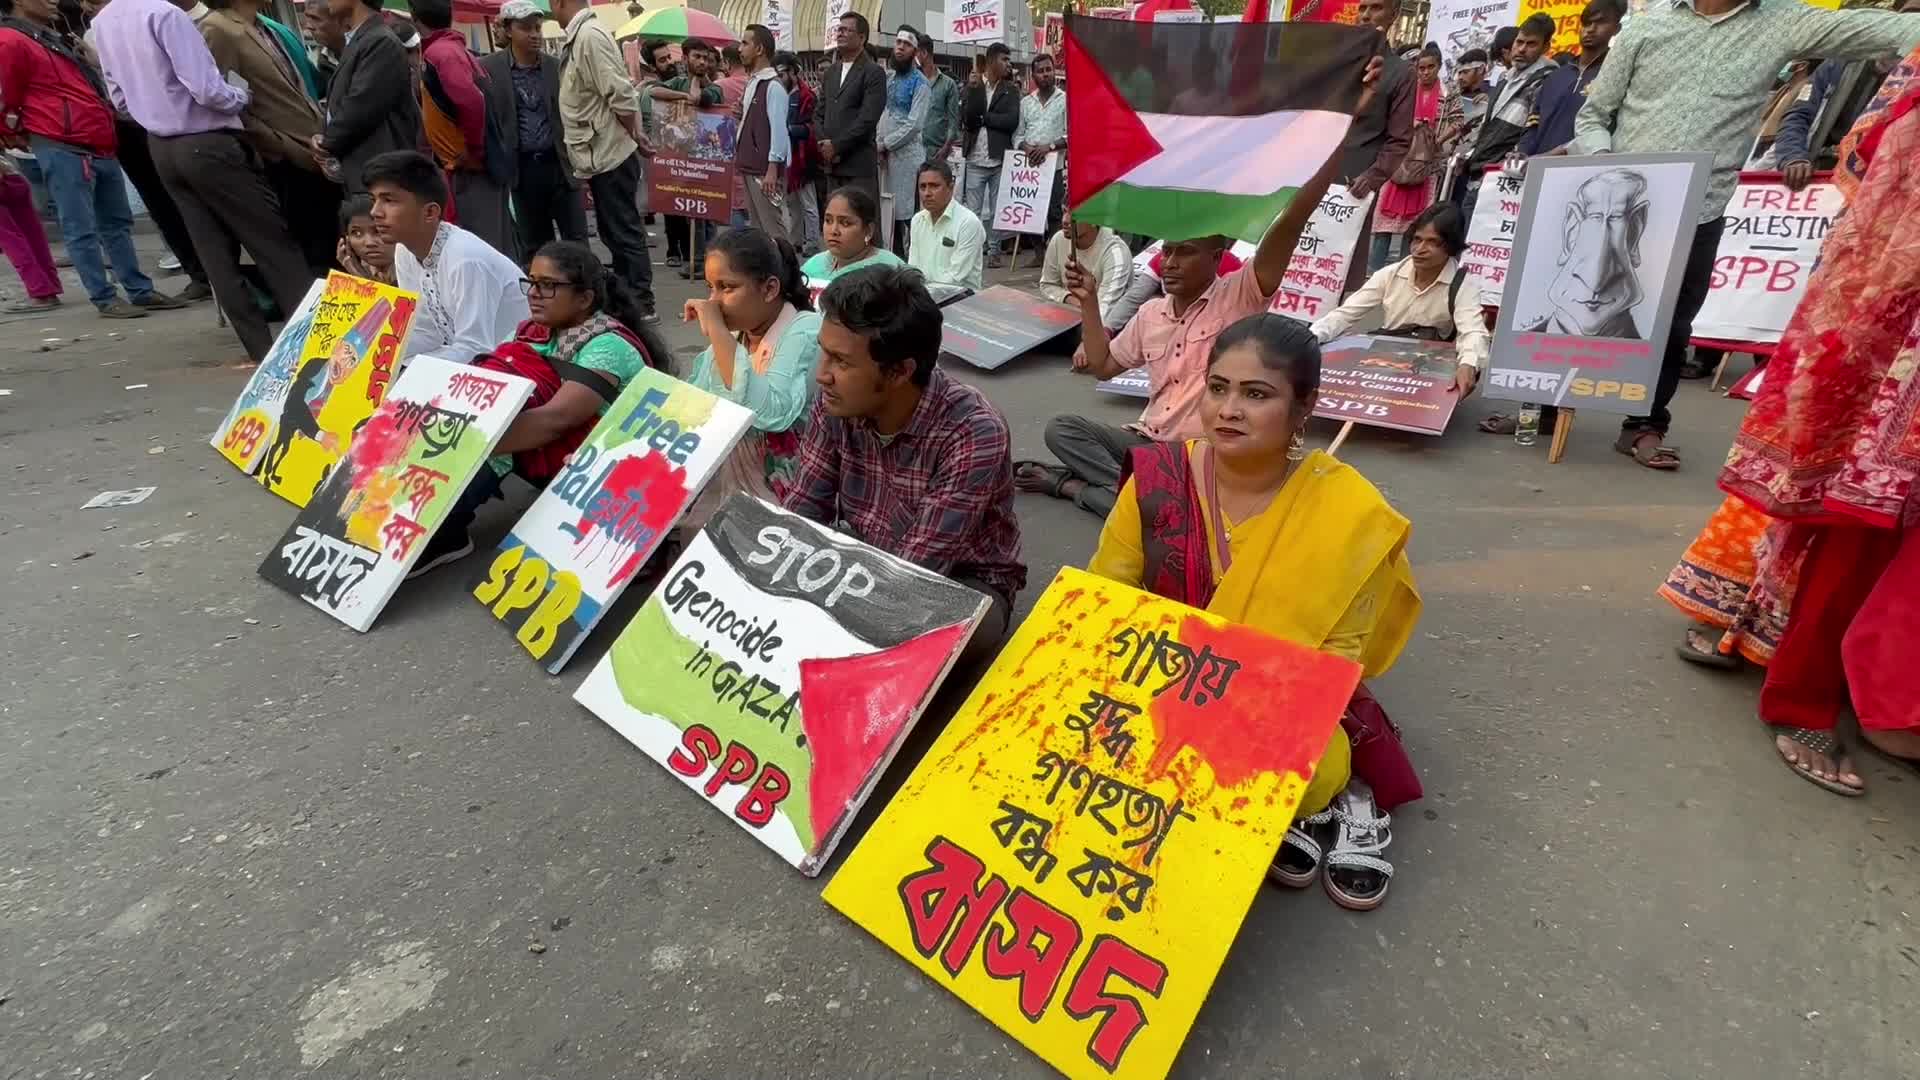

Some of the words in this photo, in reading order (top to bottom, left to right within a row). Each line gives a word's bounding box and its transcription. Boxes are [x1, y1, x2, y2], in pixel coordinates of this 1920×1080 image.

[952, 12, 997, 35] বাসদ
[1452, 9, 1470, 20] FREE
[1471, 1, 1508, 17] PALESTINE
[1010, 186, 1039, 199] NOW
[1011, 170, 1040, 186] WAR
[674, 197, 708, 214] SPB
[1001, 206, 1034, 225] SSF
[1743, 188, 1825, 212] FREE
[1501, 220, 1517, 235] চা
[1723, 215, 1834, 240] PALESTIN
[1467, 242, 1512, 261] সমাজত
[1708, 255, 1801, 293] SPB
[448, 371, 509, 412] গাজায়
[1319, 367, 1348, 377] ree
[1350, 369, 1433, 388] Palestine
[1490, 367, 1561, 394] বাসদ
[1568, 376, 1649, 402] SPB
[1316, 397, 1390, 417] SPB
[1375, 395, 1441, 410] Bangladesh
[223, 415, 266, 459] SPB
[619, 387, 701, 466] Free
[383, 513, 427, 561] কর
[280, 525, 382, 610] বাসদ
[746, 525, 876, 608] STOP
[472, 544, 583, 660] SPB
[663, 560, 784, 664] Genocide
[684, 639, 712, 679] in
[1112, 627, 1242, 707] গাজায়
[667, 723, 791, 829] SPB
[1065, 848, 1156, 922] কর
[897, 834, 1169, 1074] বাসদ
